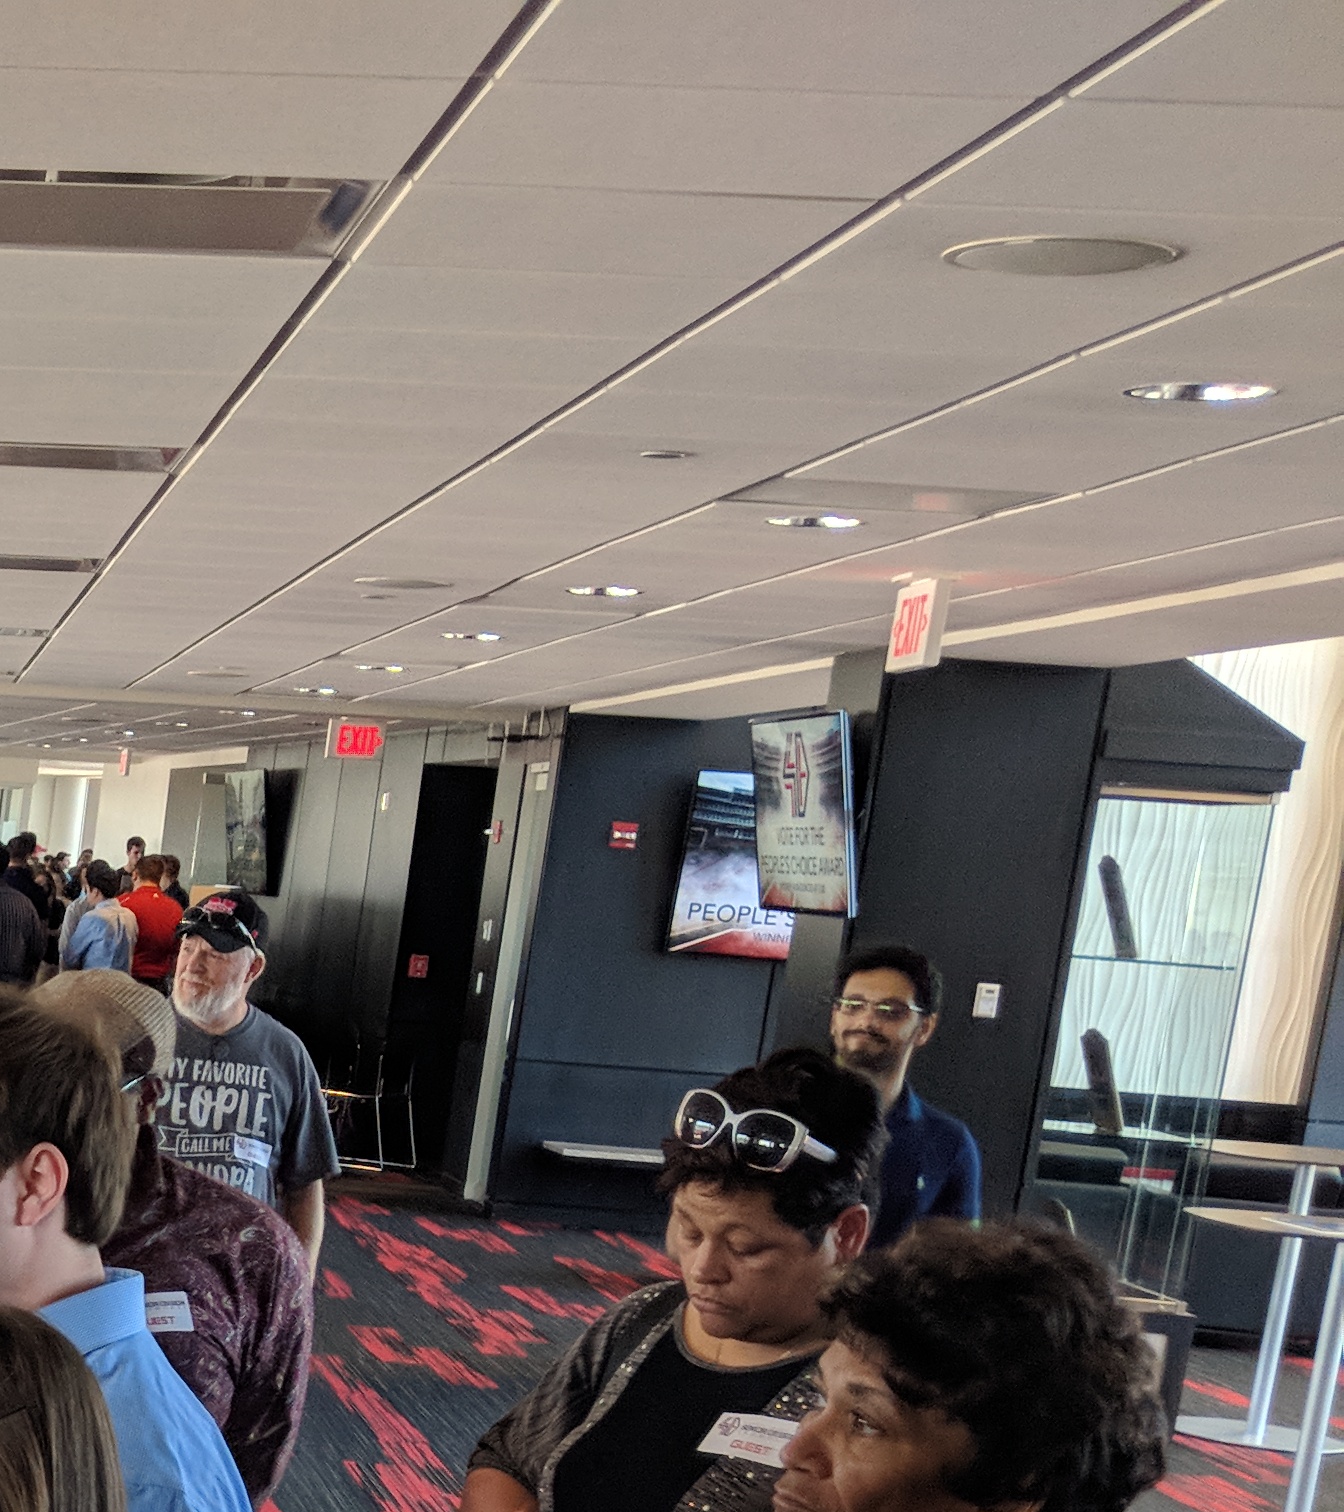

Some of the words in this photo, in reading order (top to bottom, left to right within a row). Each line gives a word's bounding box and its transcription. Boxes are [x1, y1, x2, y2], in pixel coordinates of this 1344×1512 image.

[894, 593, 927, 656] EXIT
[337, 725, 379, 756] EXIT
[778, 827, 793, 845] VOTE
[795, 827, 809, 845] FOR
[811, 827, 824, 845] THE
[791, 856, 817, 875] CHOICE
[819, 857, 844, 876] AWARD
[688, 902, 795, 927] PEOPLE'S
[193, 1059, 270, 1090] FAVORITE
[181, 1138, 210, 1152] CALL
[730, 1439, 773, 1456] GUEST
